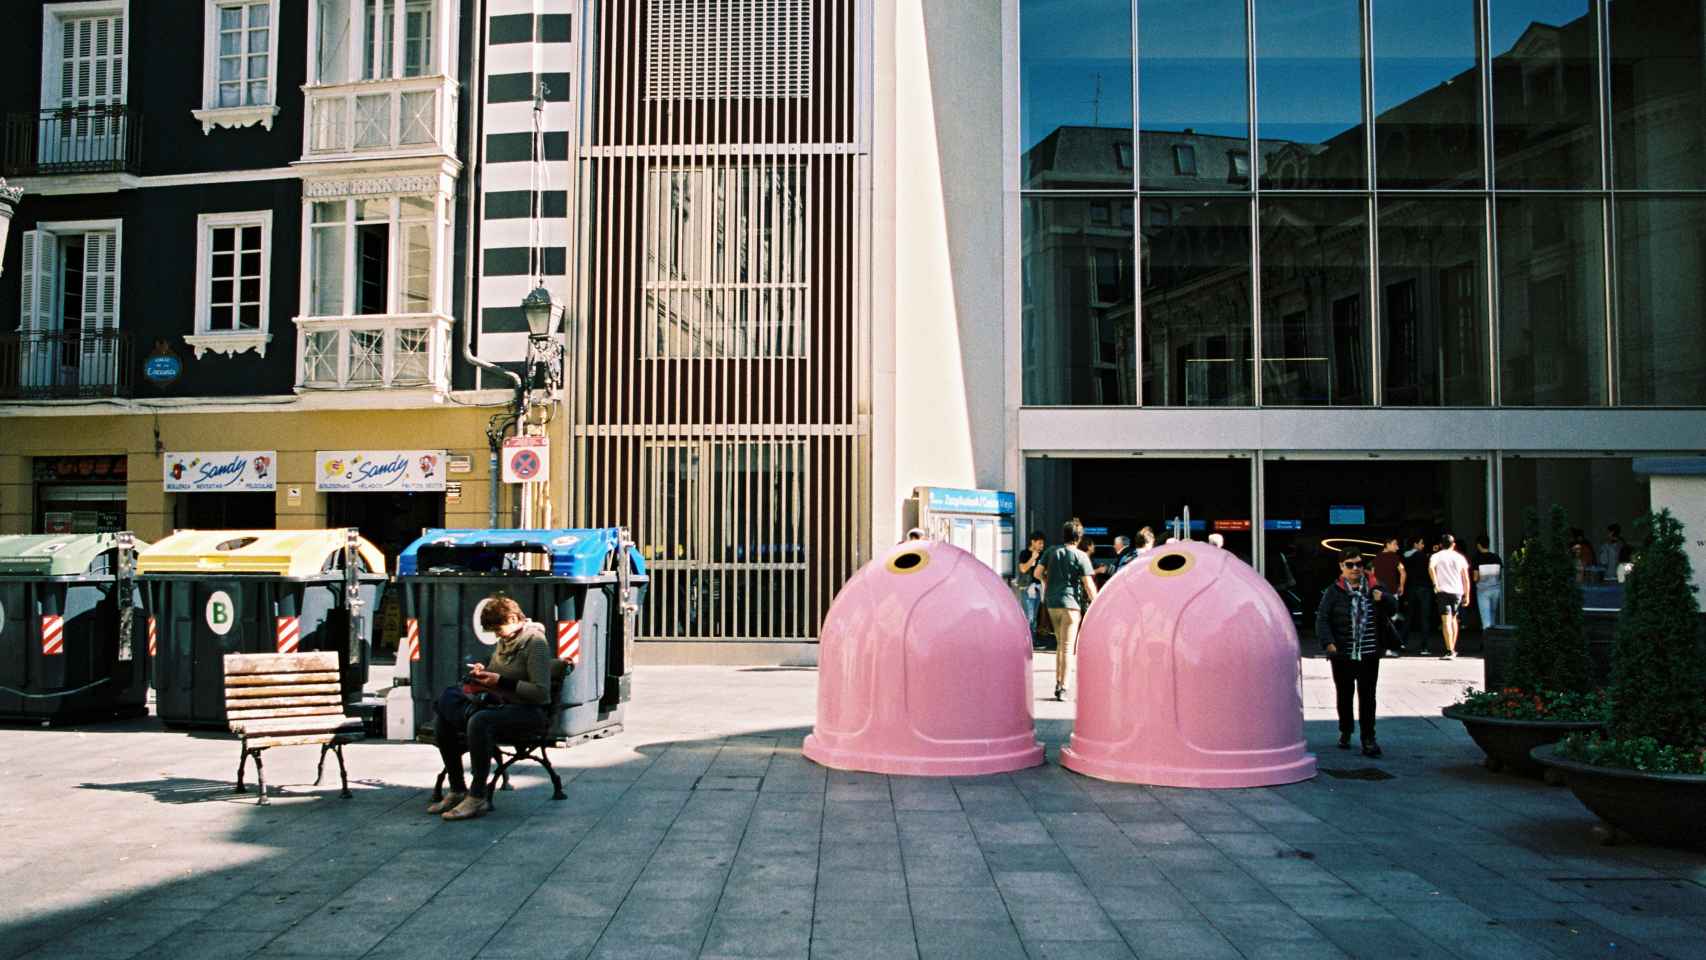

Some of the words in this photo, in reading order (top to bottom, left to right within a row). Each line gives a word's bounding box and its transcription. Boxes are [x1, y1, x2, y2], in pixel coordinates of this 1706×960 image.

[193, 456, 247, 486] Sandy
[351, 454, 408, 486] Sandy
[213, 602, 227, 624] B
